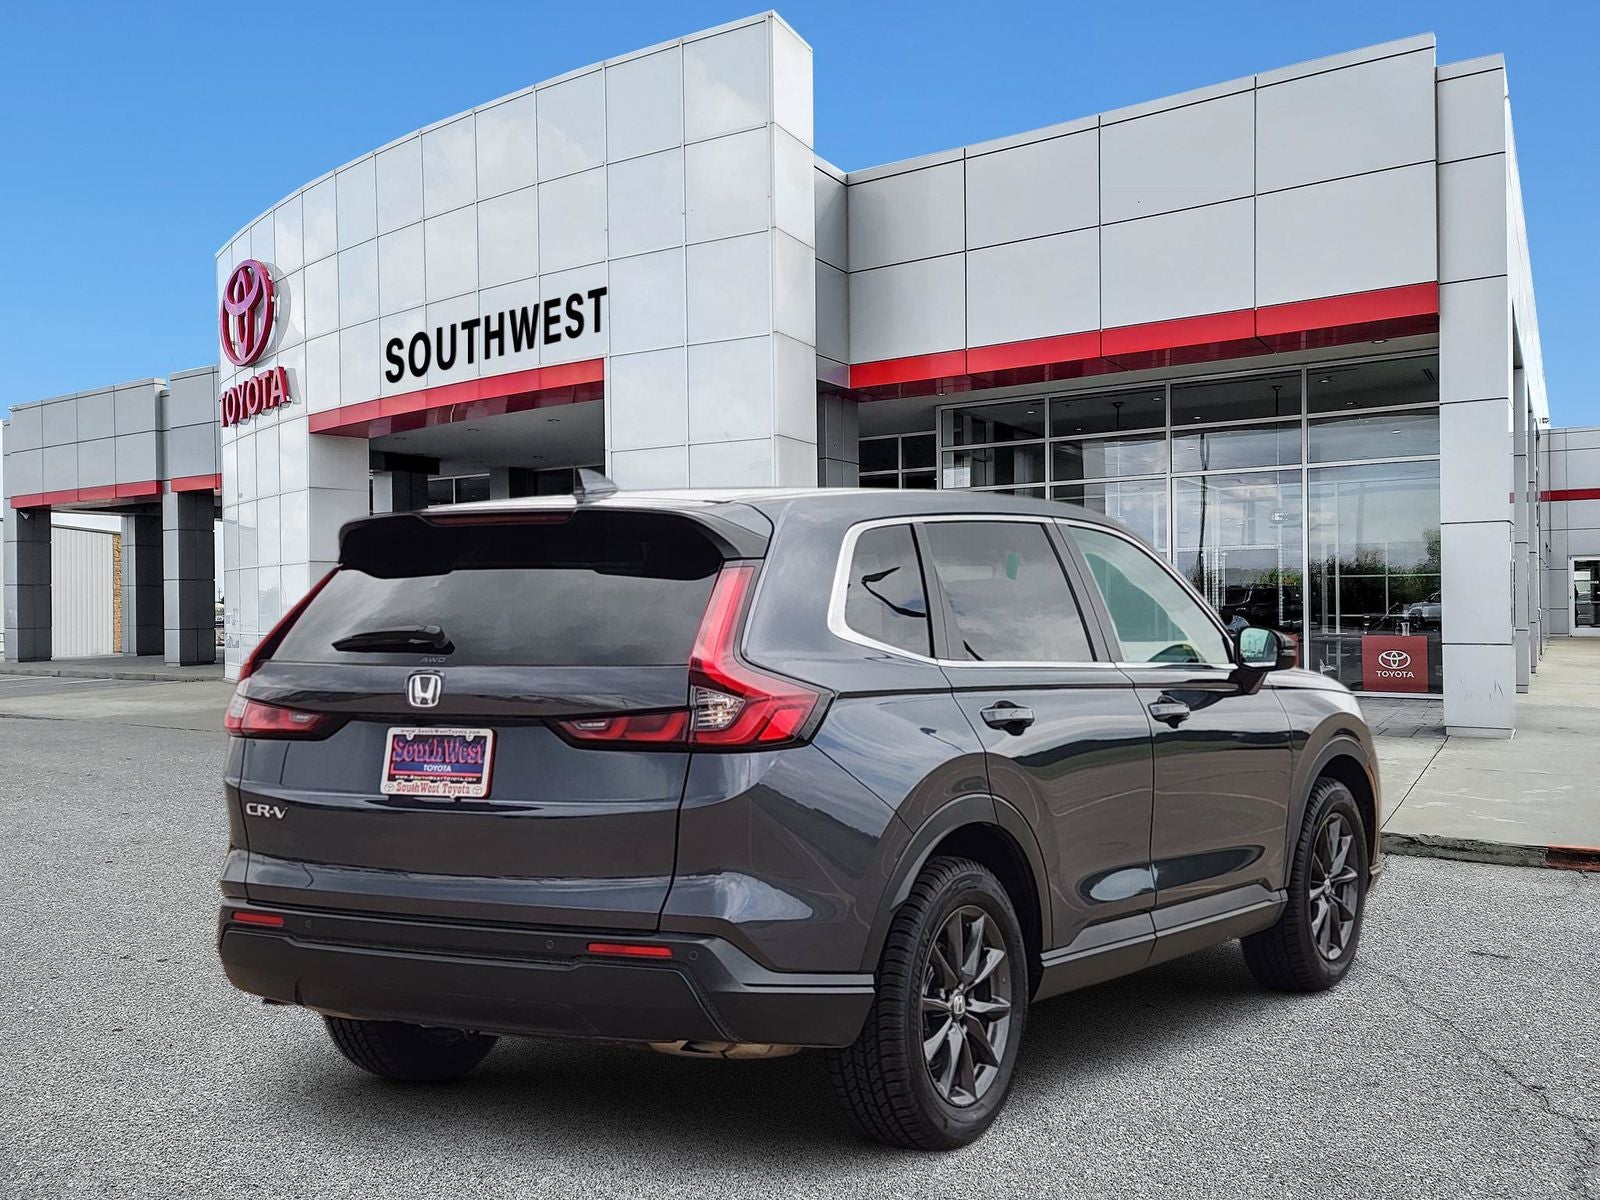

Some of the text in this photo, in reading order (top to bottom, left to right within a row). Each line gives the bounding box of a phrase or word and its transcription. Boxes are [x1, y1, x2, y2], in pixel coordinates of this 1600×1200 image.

[385, 286, 607, 384] SOUTHWEST
[219, 366, 291, 428] TOYOTA
[1376, 670, 1414, 678] TOYOTA
[423, 764, 452, 772] TOYOTA
[442, 783, 470, 796] Toyota
[245, 803, 288, 819] CR-V
